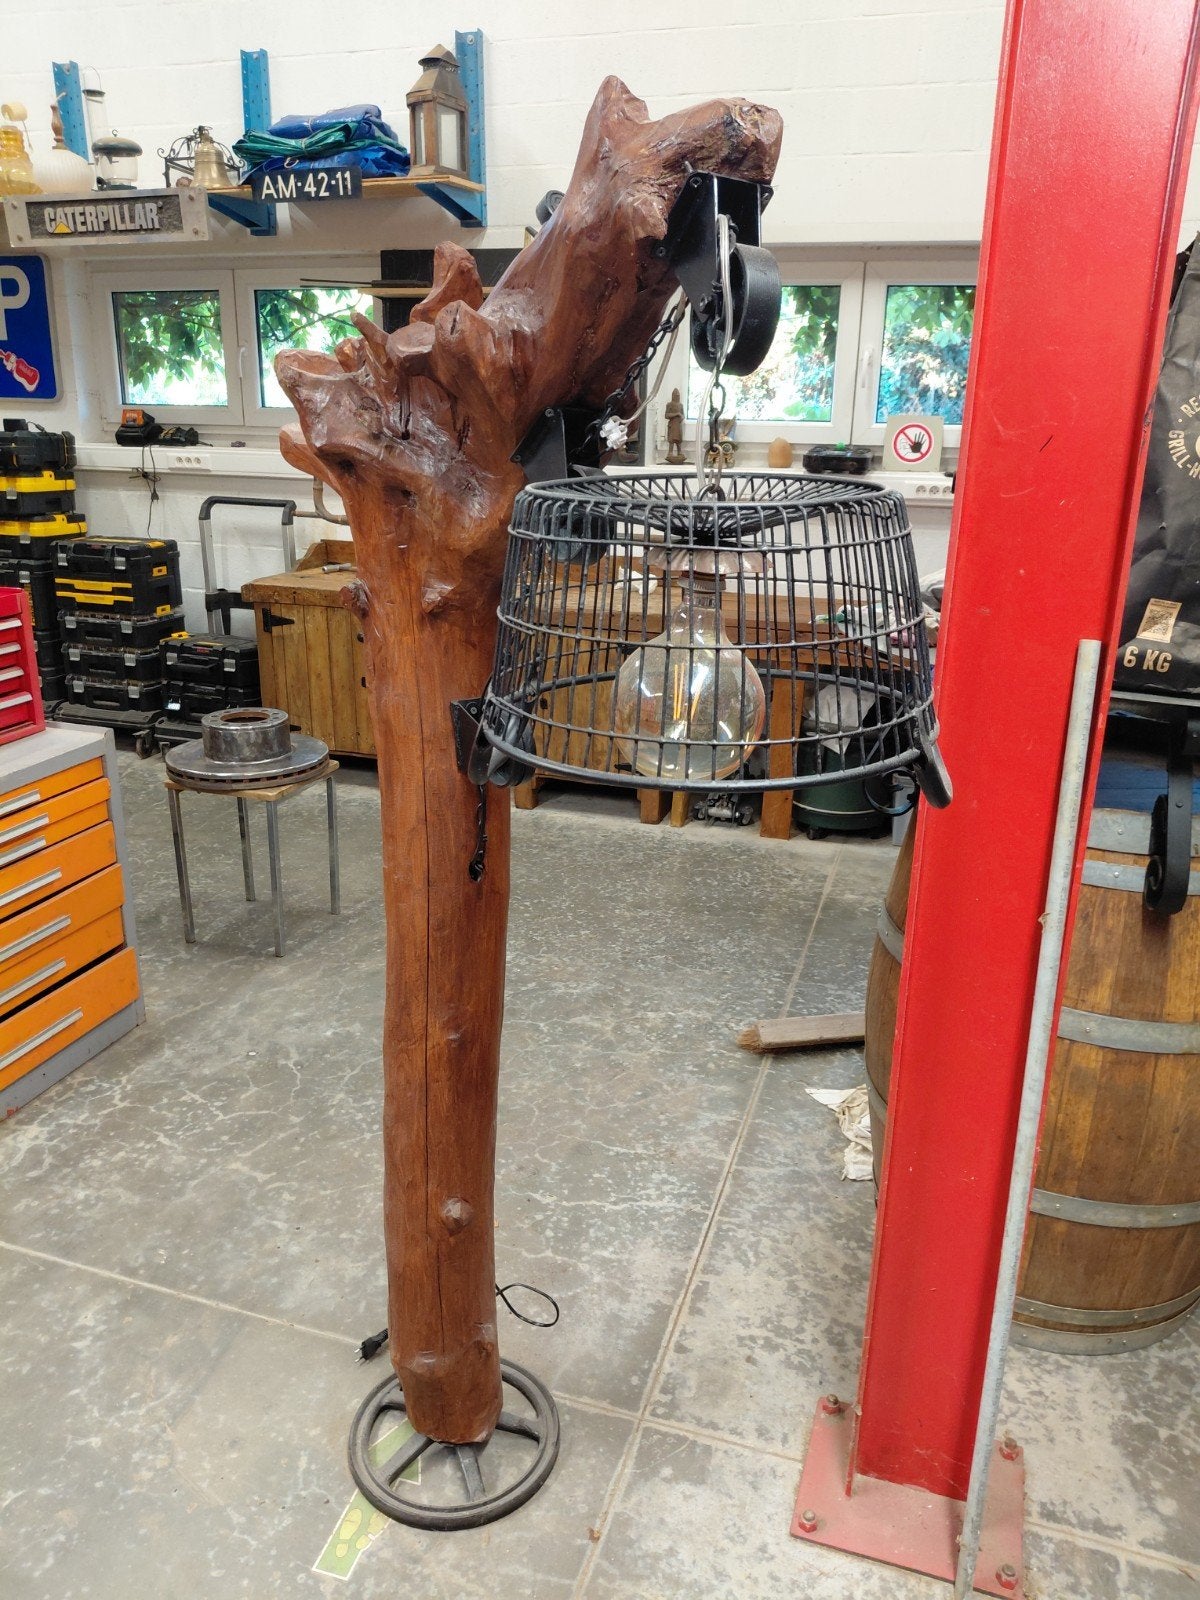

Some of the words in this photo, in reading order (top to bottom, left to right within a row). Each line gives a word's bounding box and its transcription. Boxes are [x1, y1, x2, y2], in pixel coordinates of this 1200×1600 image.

[44, 202, 160, 233] CATERPILLAR
[0, 265, 31, 341] P
[1180, 395, 1200, 418] RE
[1168, 430, 1200, 480] GRILL-H
[1123, 645, 1139, 668] 6
[1142, 649, 1172, 673] KG
